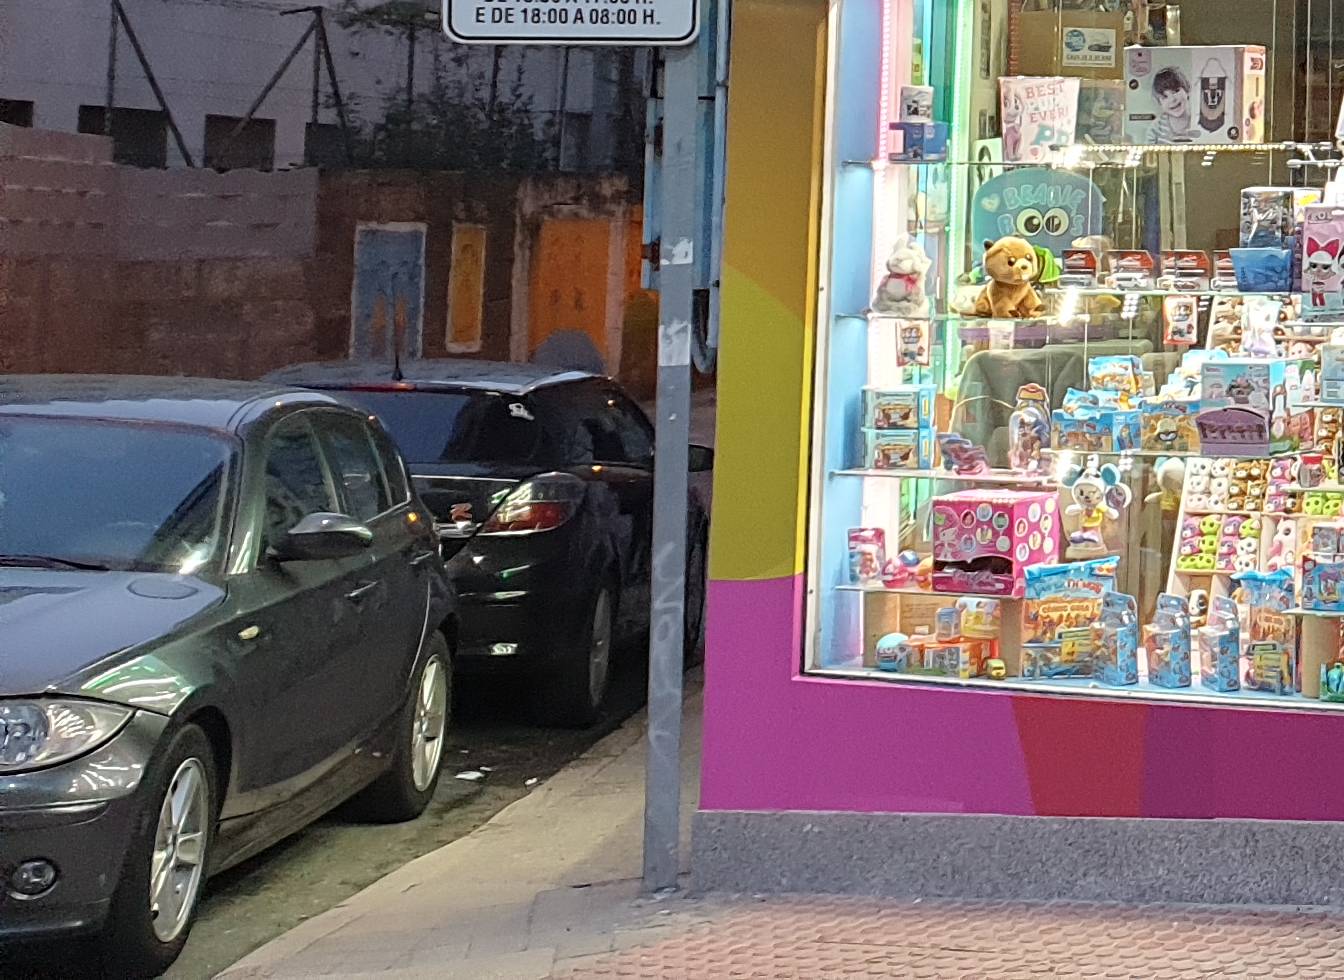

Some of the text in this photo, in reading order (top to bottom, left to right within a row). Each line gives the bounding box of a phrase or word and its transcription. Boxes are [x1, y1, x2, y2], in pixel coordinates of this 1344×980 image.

[476, 7, 661, 26] E DE 18:00 A 08:00 H.
[1026, 82, 1065, 100] BEST
